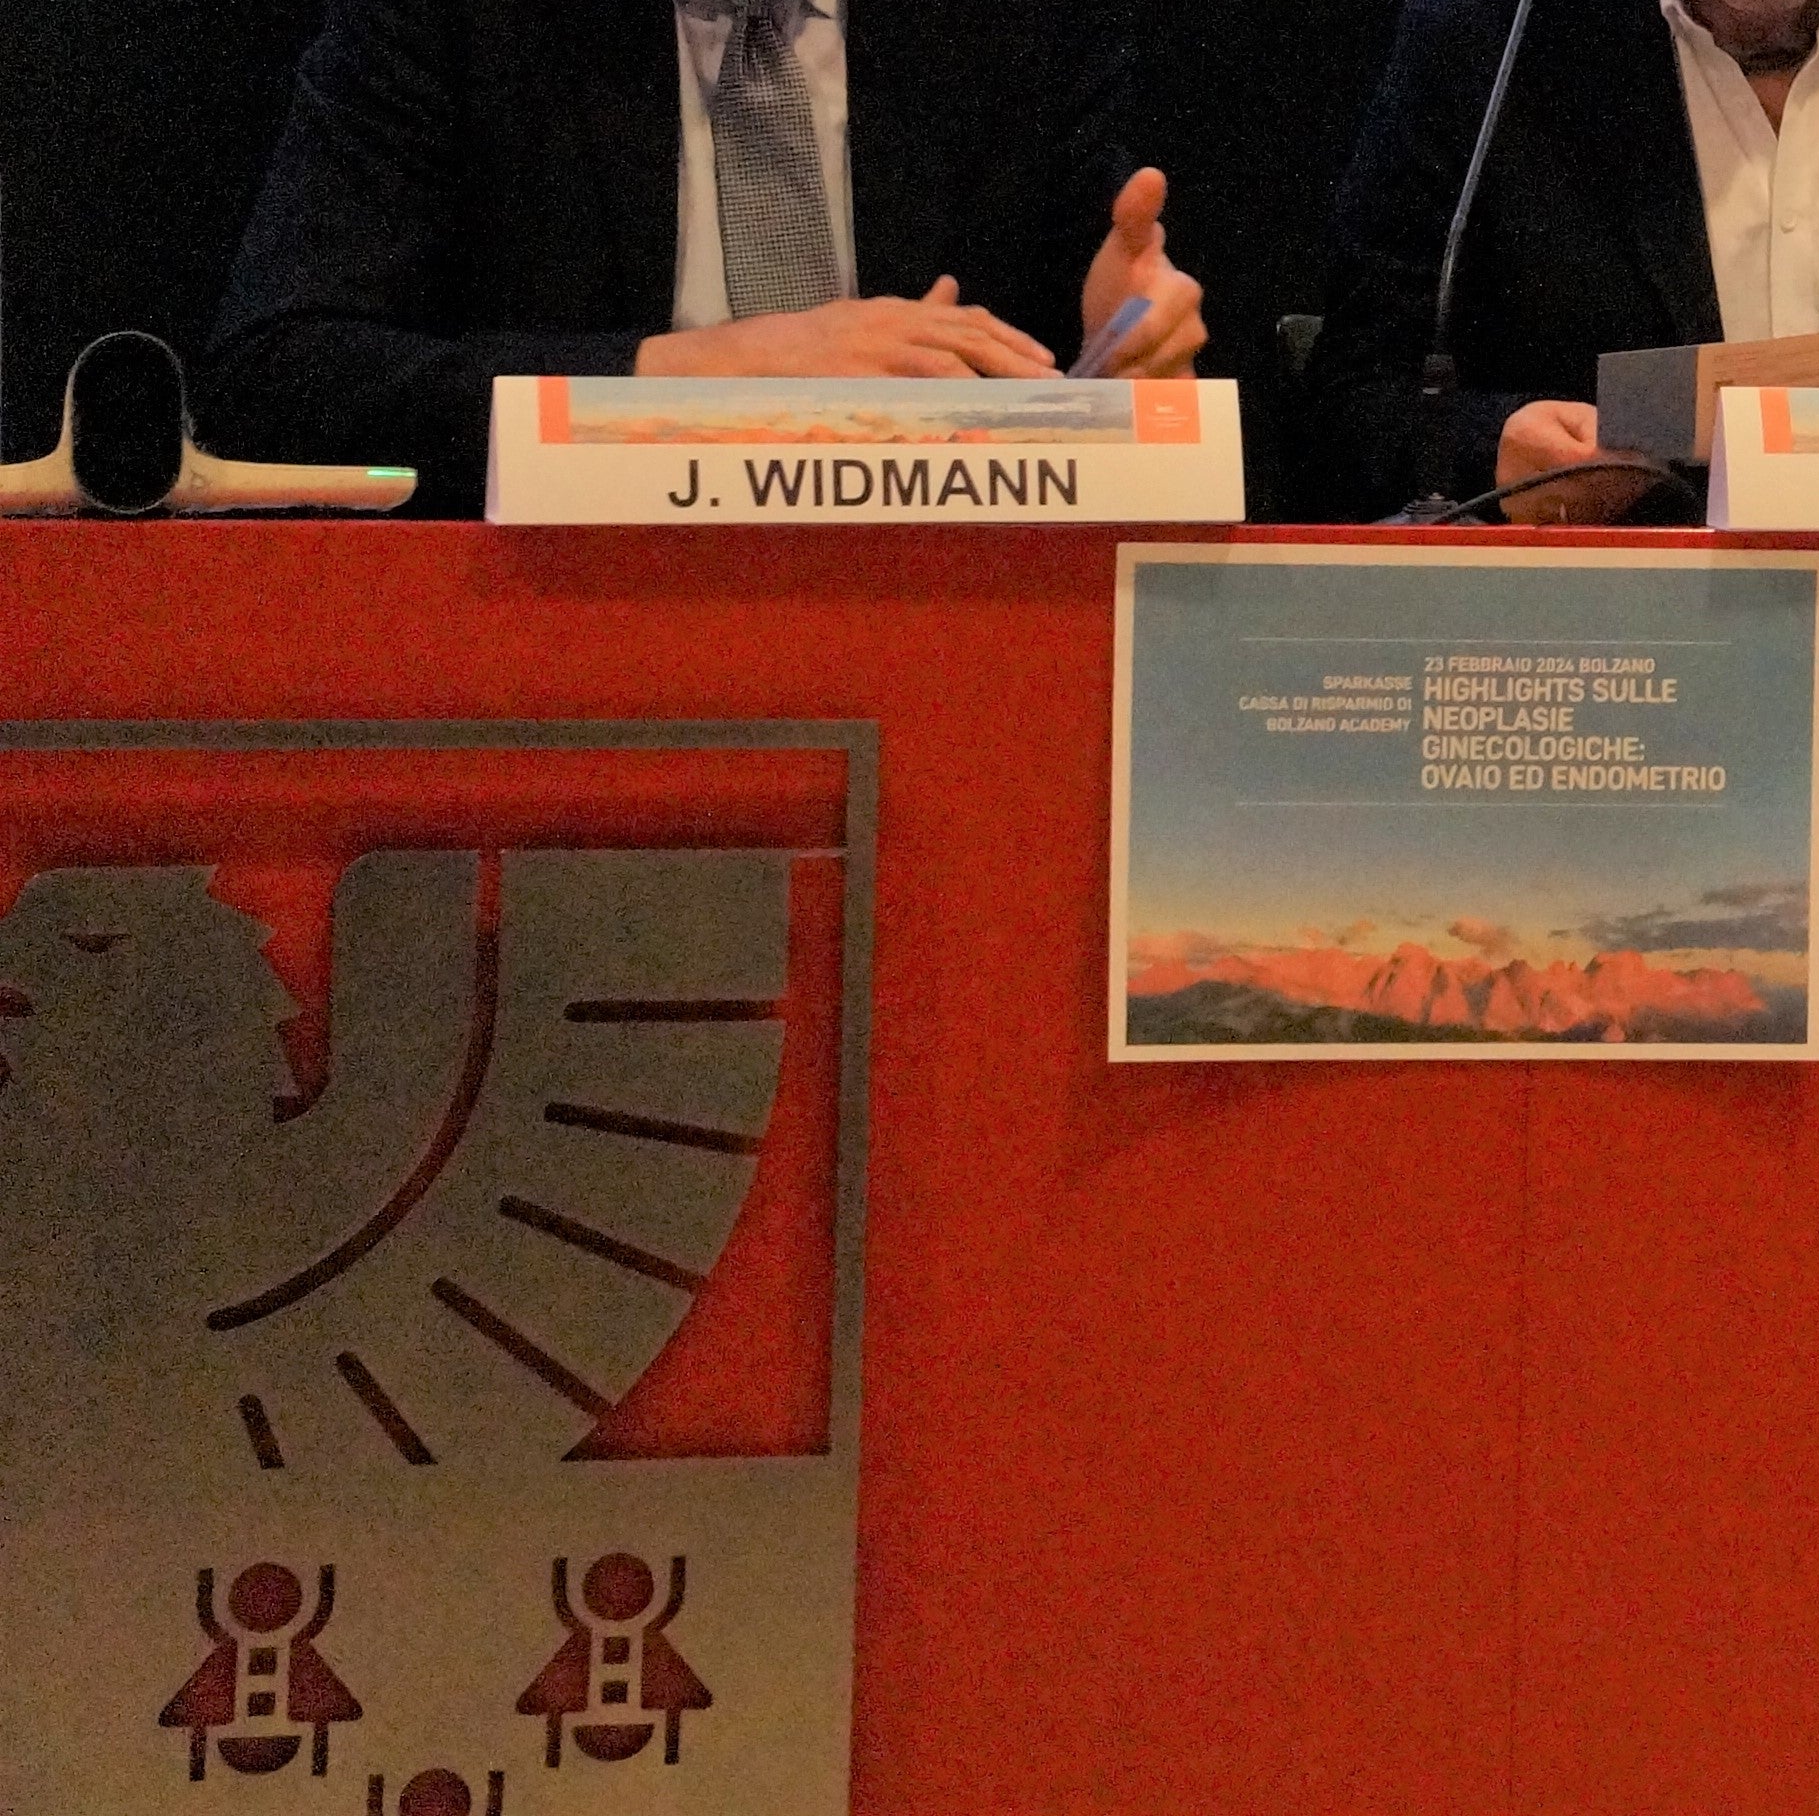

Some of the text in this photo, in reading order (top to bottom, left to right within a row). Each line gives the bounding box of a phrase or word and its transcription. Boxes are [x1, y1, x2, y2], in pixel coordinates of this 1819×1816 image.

[668, 457, 1080, 508] J. WIDMANN
[1424, 657, 1655, 673] 23 FEBBRAIO 2024 BOLZANO
[1322, 675, 1413, 691] SPARKASSE
[1424, 677, 1678, 703] HIGHLIGHTS SULLE
[1239, 696, 1412, 711] CASSA DI RISPARMIO DI
[1266, 716, 1412, 732] BOLZANO ACADEMY
[1423, 706, 1574, 731] NEOPLASIE
[1422, 735, 1645, 761] GINECOLOGICHE:
[1421, 765, 1726, 791] OVAIO ED ENDOMETRIO
